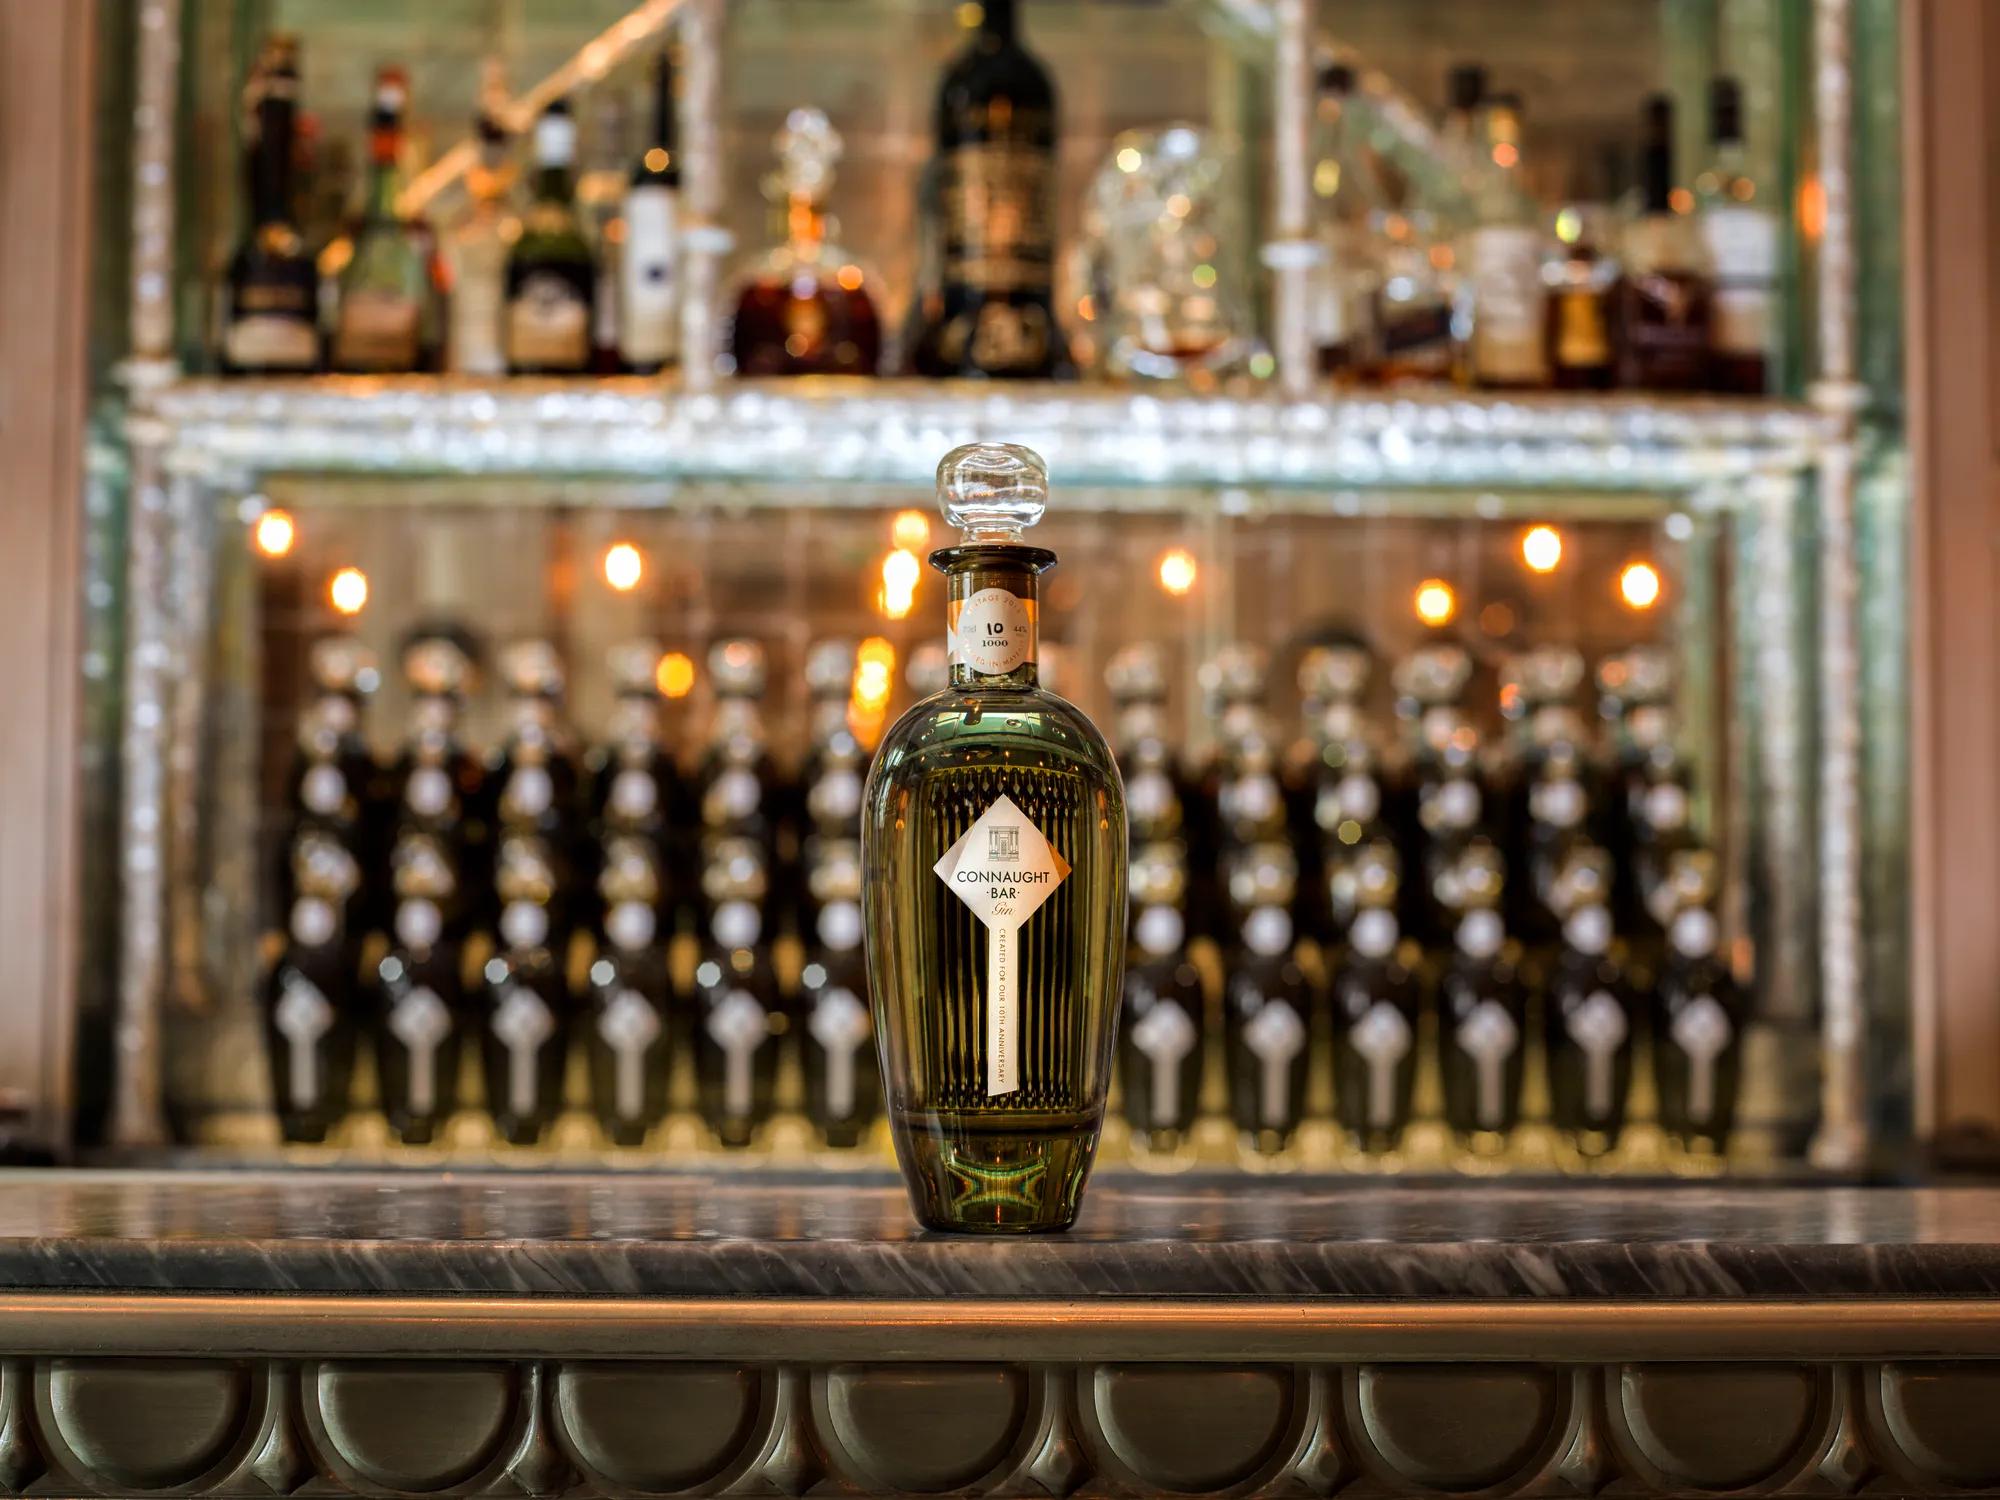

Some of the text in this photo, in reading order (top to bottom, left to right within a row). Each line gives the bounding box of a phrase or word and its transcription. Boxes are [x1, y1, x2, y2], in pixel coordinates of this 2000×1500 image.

[987, 623, 1004, 636] 10
[982, 640, 1009, 648] 1000
[956, 870, 1050, 884] CONNAUGHT
[991, 901, 1016, 916] Gin
